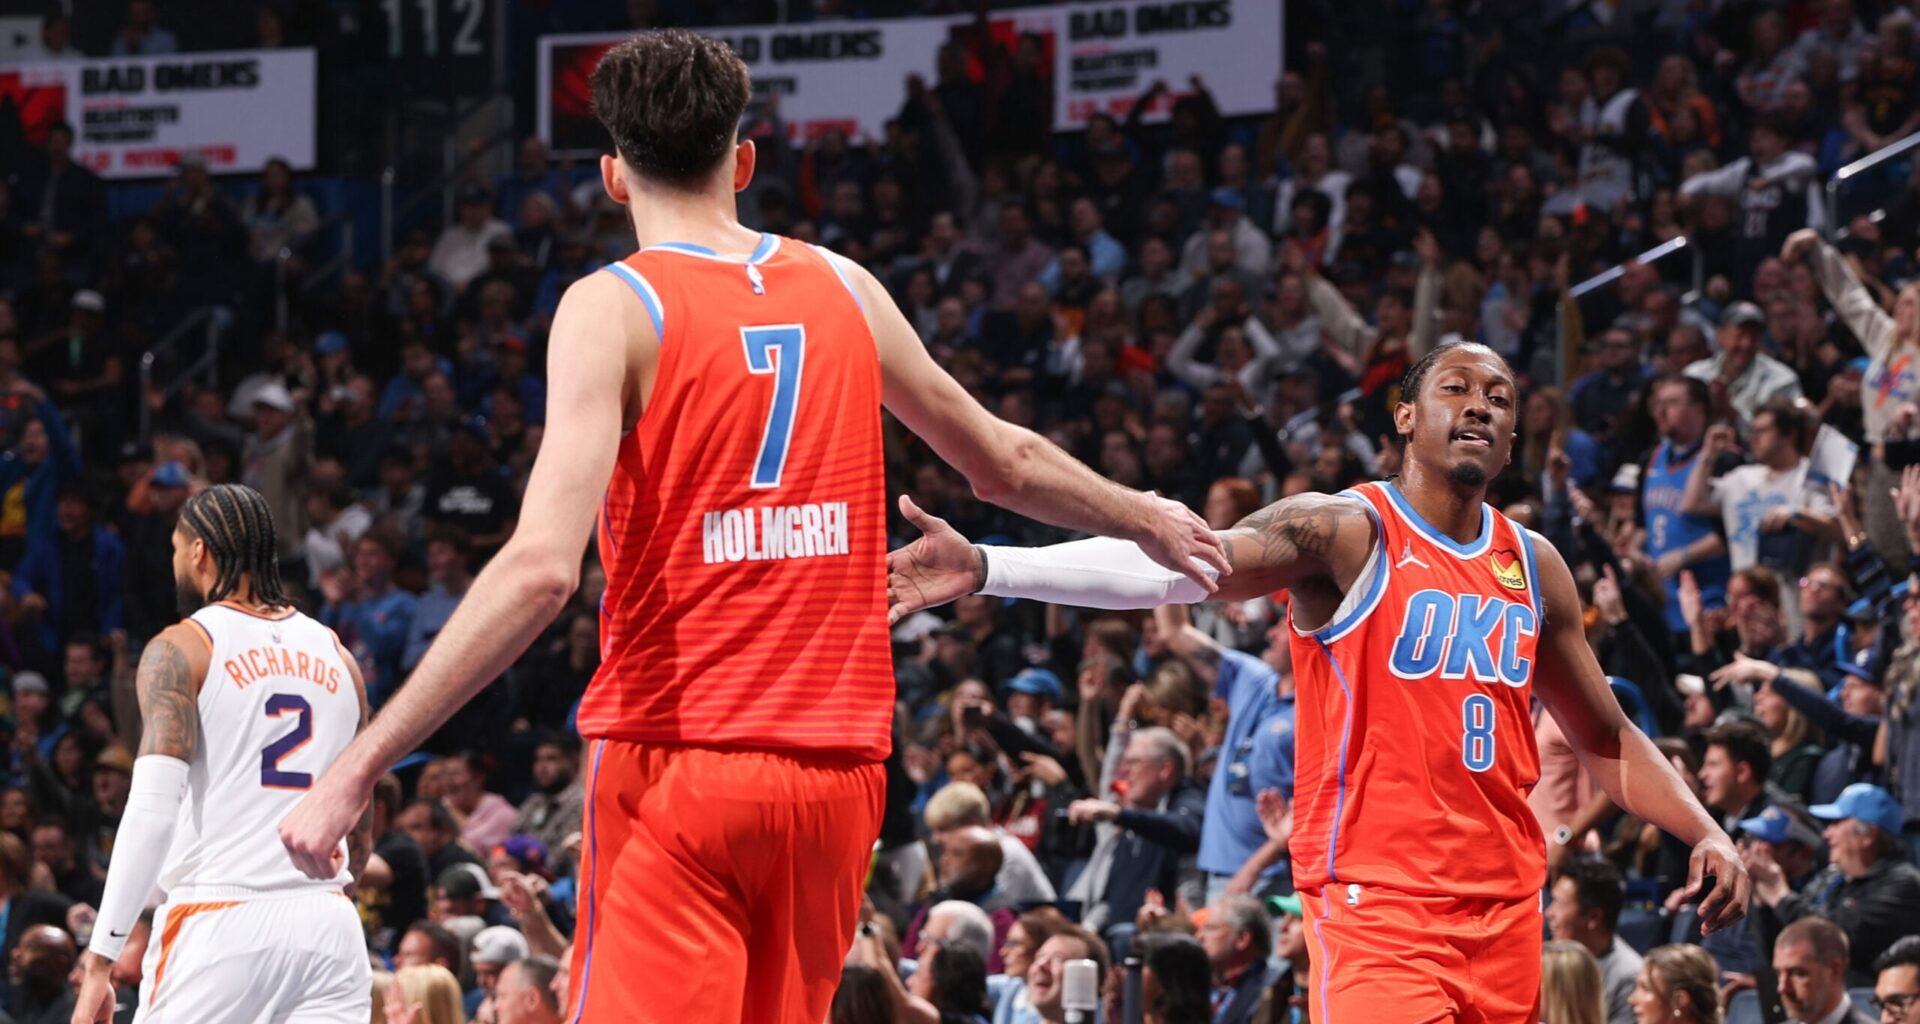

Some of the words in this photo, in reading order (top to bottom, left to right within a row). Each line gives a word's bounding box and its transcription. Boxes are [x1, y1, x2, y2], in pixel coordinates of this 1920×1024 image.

[379, 0, 485, 58] 112
[770, 29, 883, 63] OMENS
[1069, 7, 1127, 42] BAD
[1135, 1, 1232, 35] OMENS
[81, 64, 146, 95] BAD
[154, 59, 259, 91] OMENS
[739, 323, 807, 489] 7
[703, 502, 849, 564] HOLMGREN
[1388, 588, 1536, 688] OKC
[224, 647, 341, 695] RICHARDS
[261, 693, 313, 791] 2
[1462, 693, 1495, 773] 8
